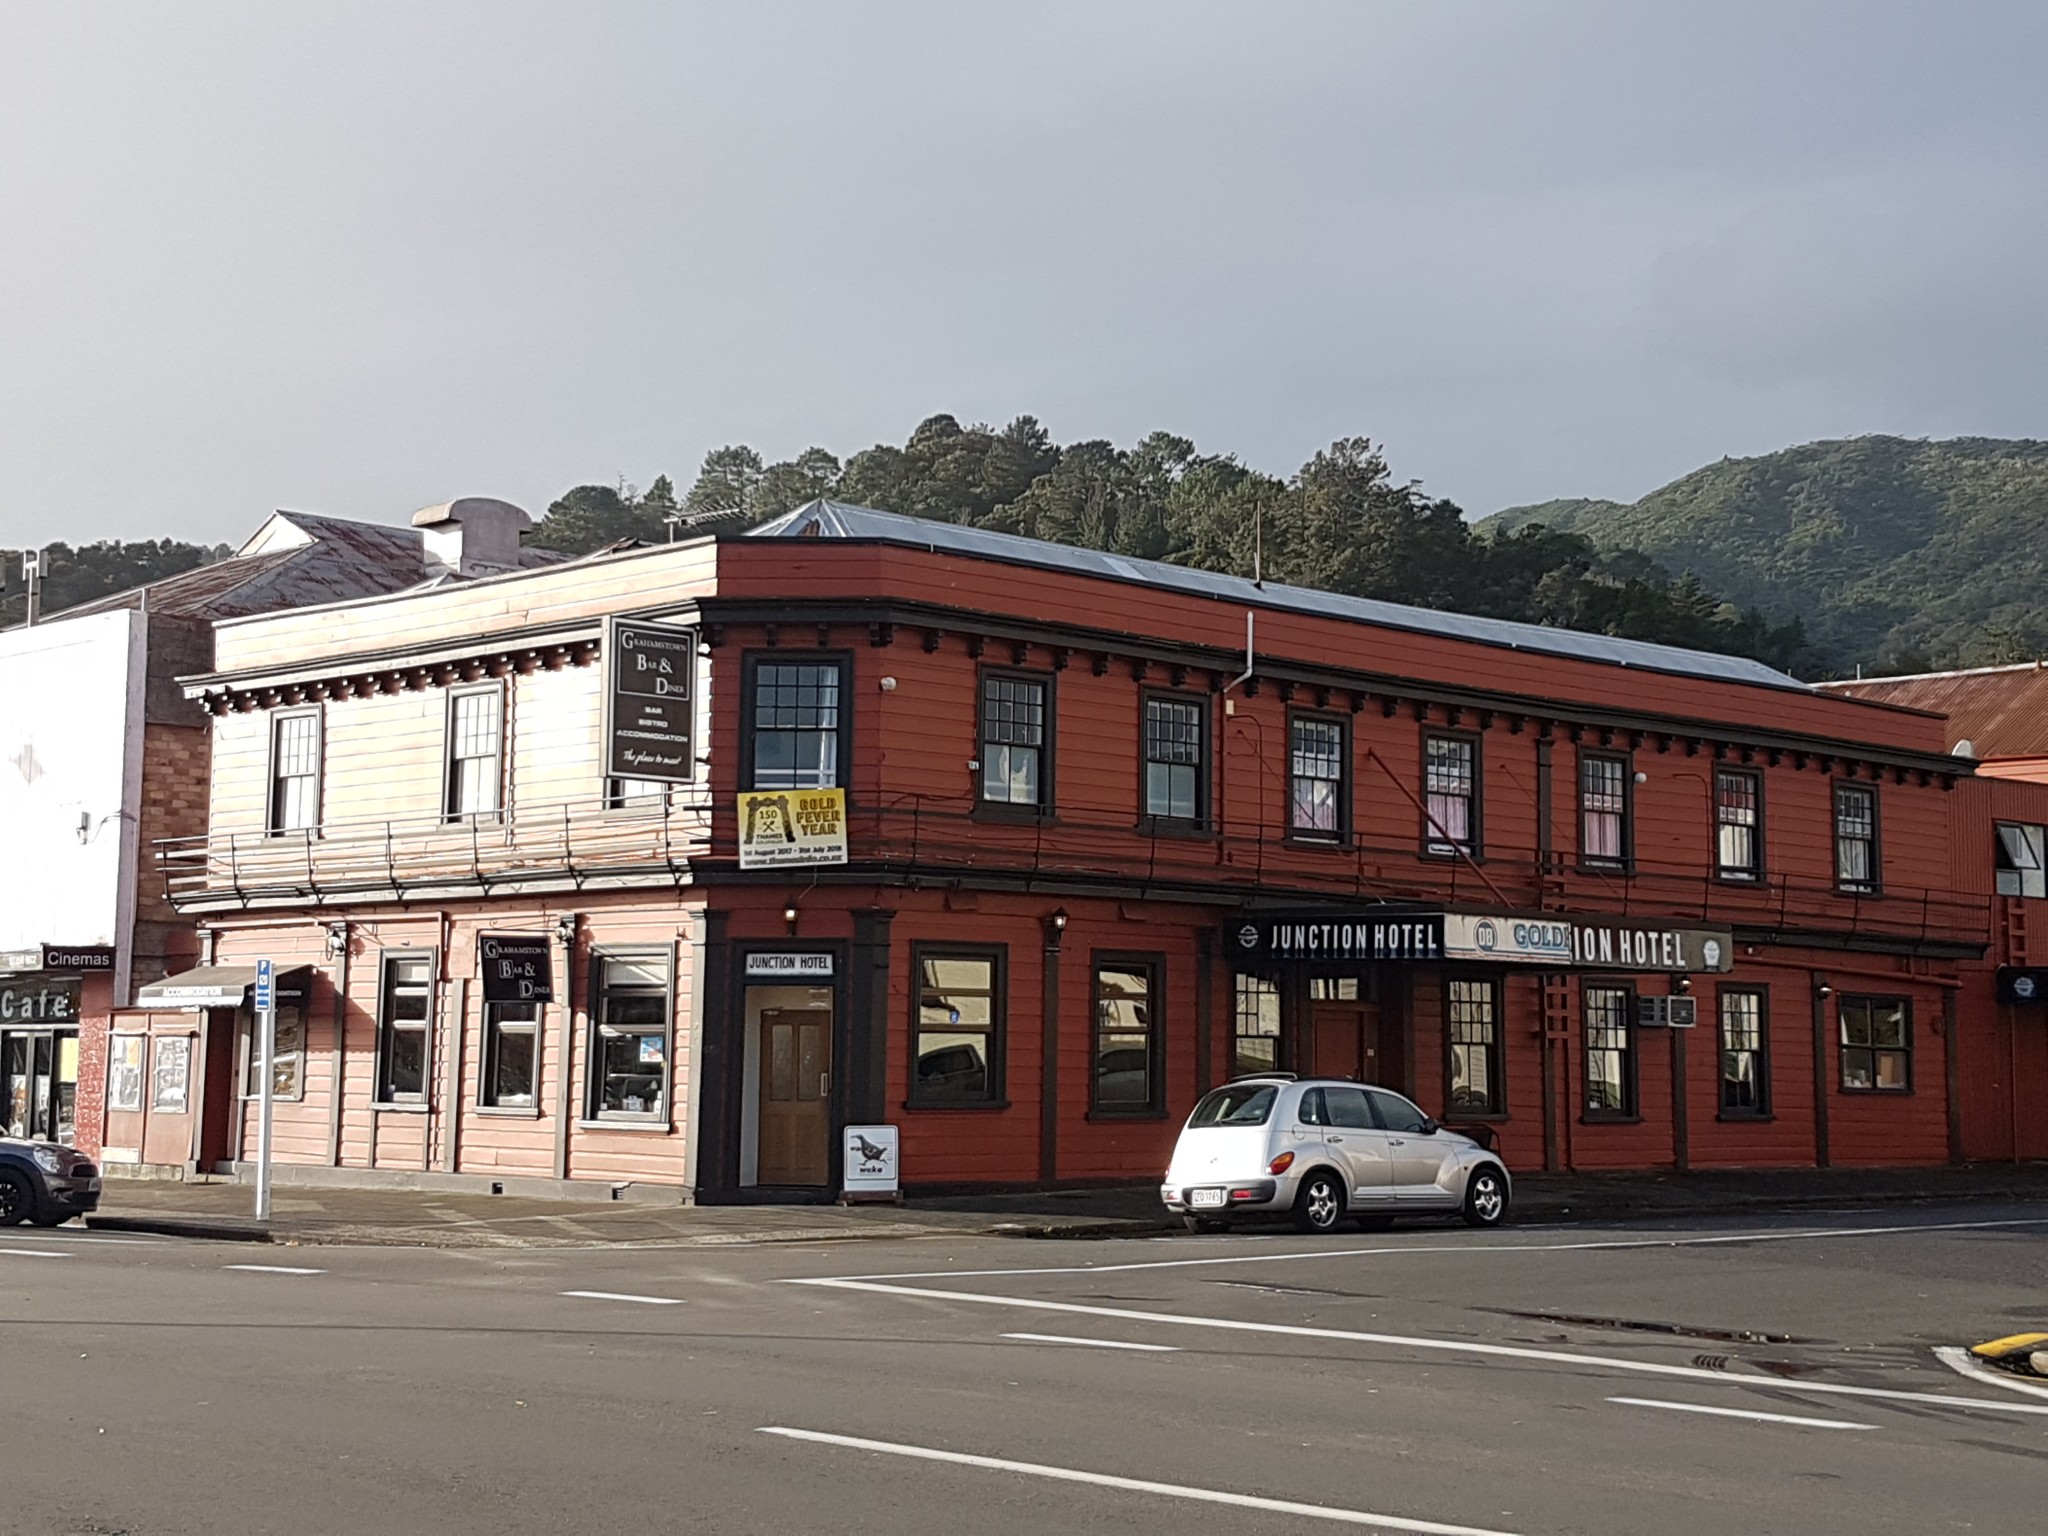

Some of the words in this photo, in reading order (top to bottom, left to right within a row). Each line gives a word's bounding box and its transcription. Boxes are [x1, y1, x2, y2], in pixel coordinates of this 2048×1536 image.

[659, 657, 674, 674] &
[645, 706, 663, 715] BAR
[616, 729, 689, 743] ACCOMMODATION
[799, 797, 836, 811] GOLD
[760, 810, 778, 820] 150
[796, 810, 841, 824] FEVER
[800, 822, 837, 836] YEAR
[1271, 925, 1367, 949] JUNCTION
[1374, 924, 1437, 949] HOTEL
[1619, 929, 1686, 966] HOTEL
[47, 952, 110, 965] Cinemas
[749, 956, 796, 969] JUNCTION
[800, 956, 829, 969] HOTEL
[524, 962, 536, 976] &
[1, 989, 67, 1018] Cafe
